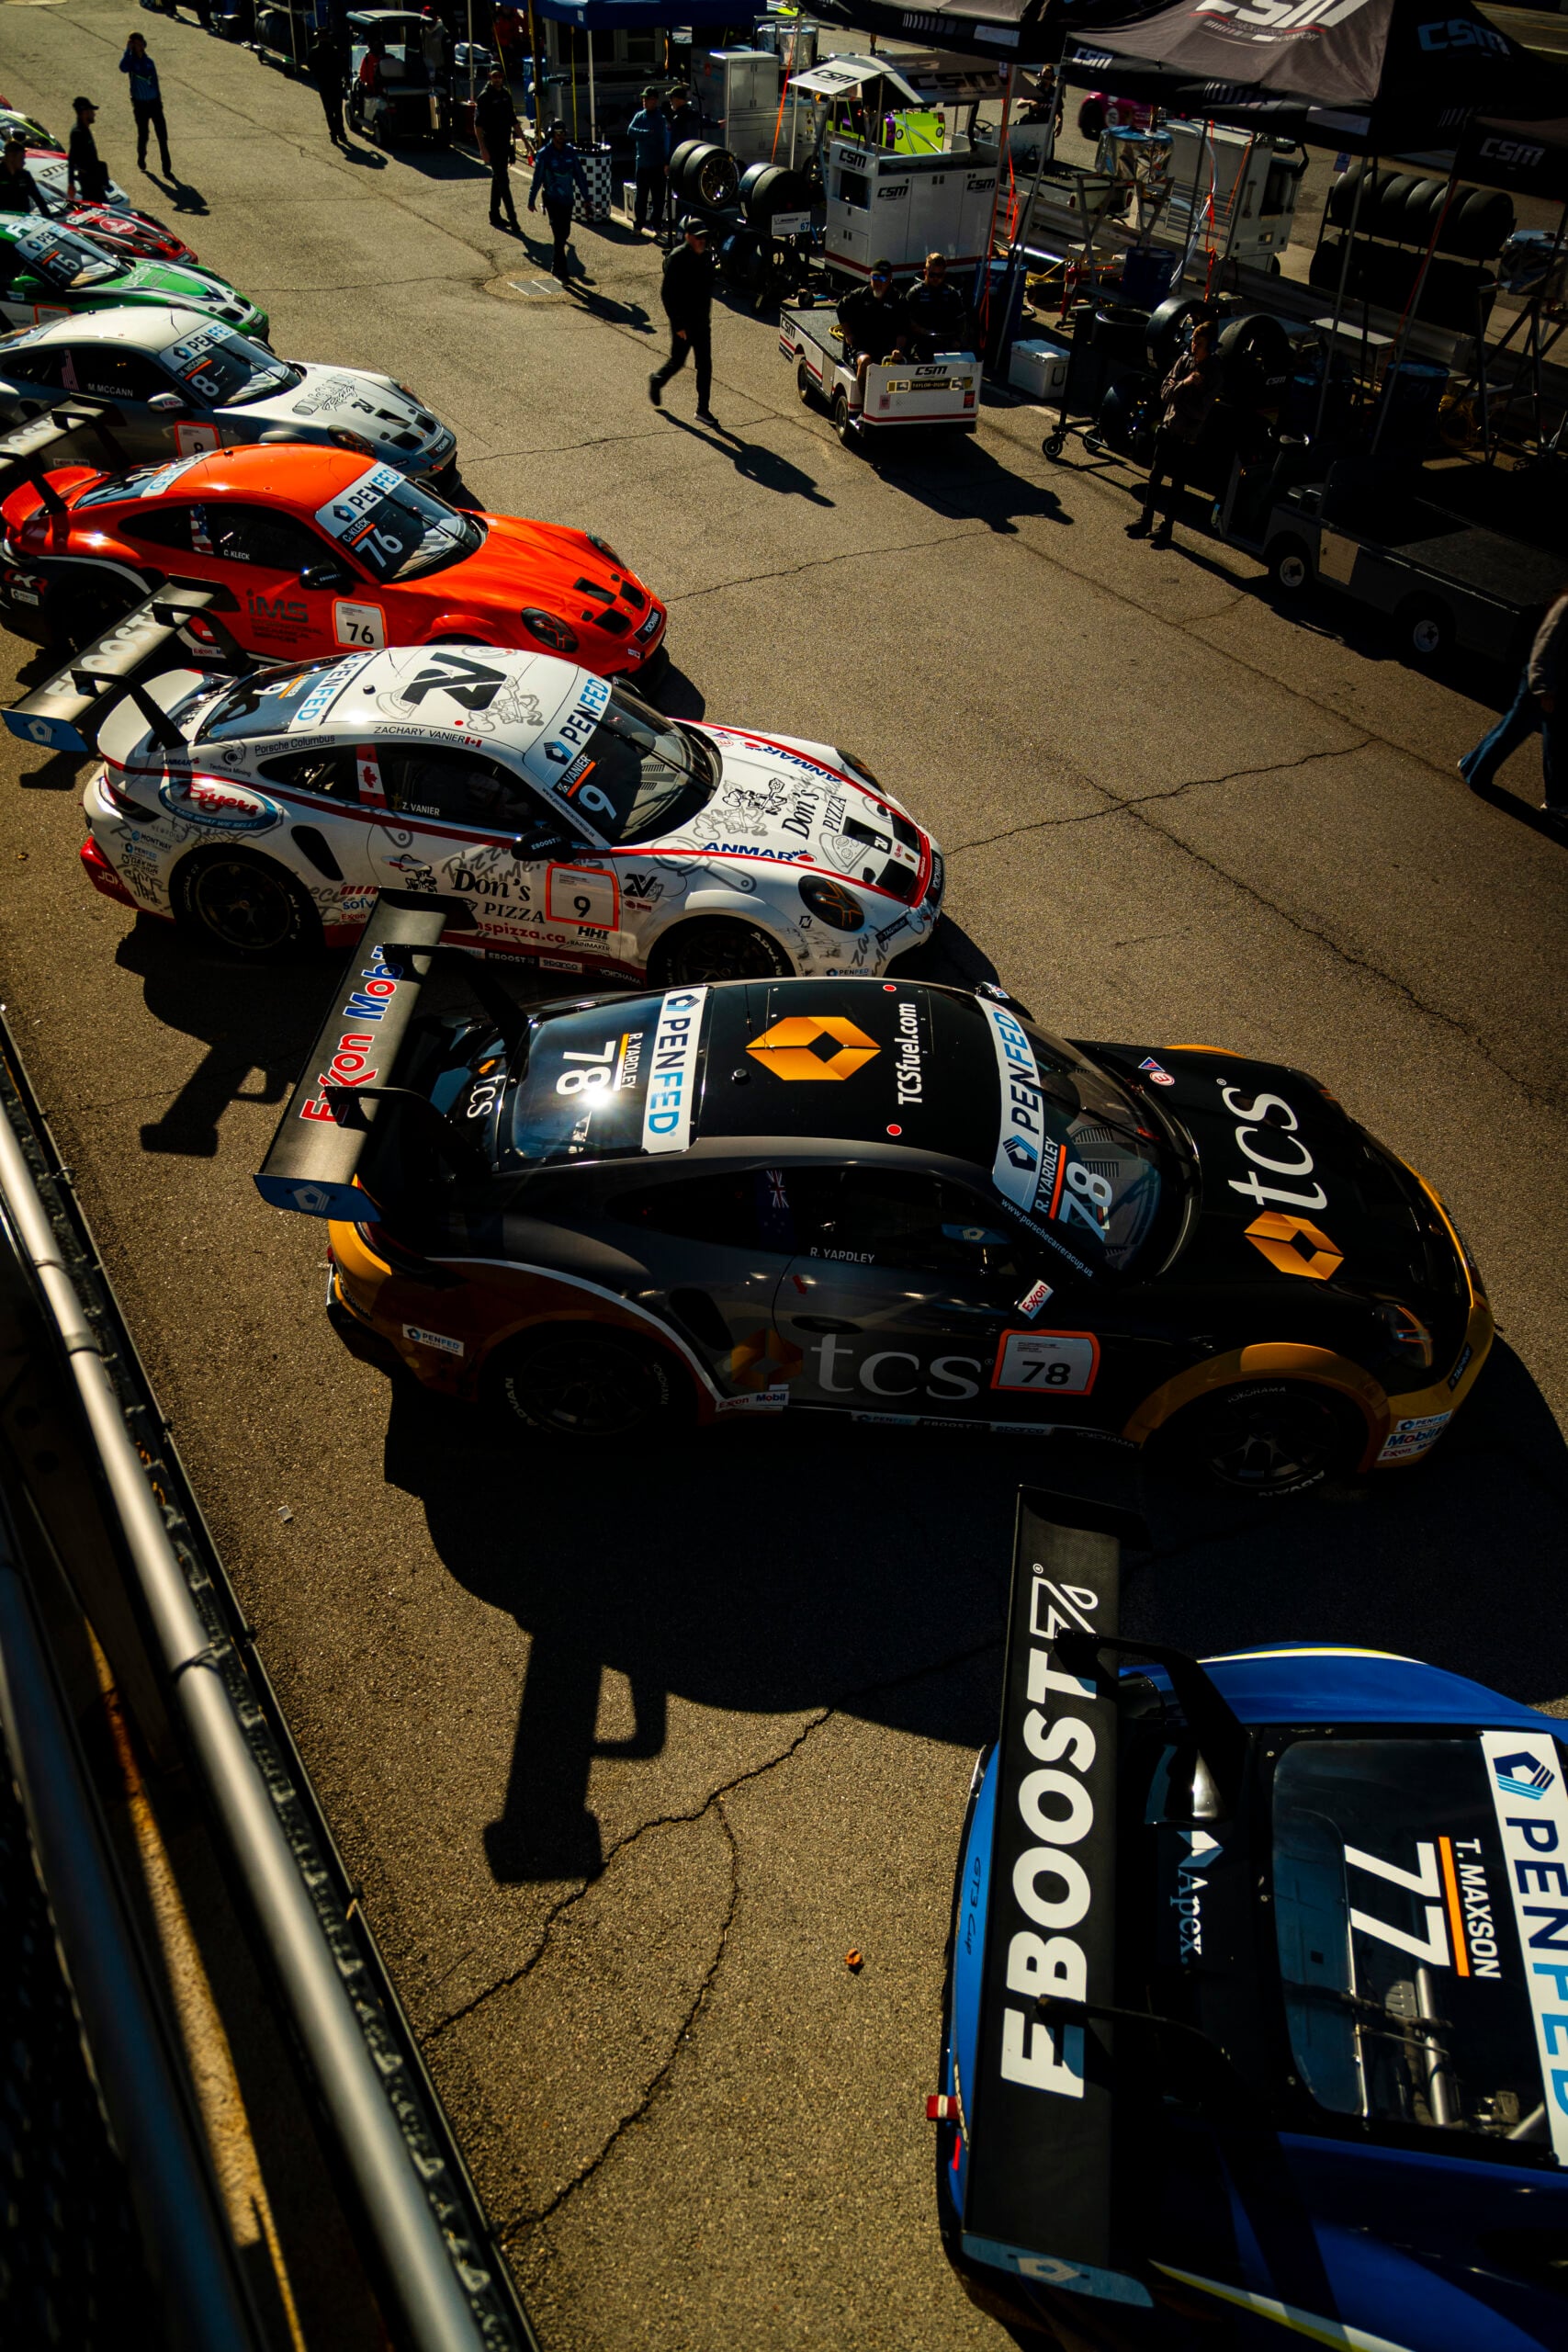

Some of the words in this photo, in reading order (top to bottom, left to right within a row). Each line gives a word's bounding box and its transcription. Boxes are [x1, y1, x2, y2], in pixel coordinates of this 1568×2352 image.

[1417, 18, 1512, 56] CSM
[1073, 47, 1113, 69] CSM
[811, 69, 860, 85] CSM
[839, 149, 867, 169] CSM
[1480, 137, 1546, 168] CSM
[877, 186, 908, 198] CSM
[967, 178, 996, 191] CSM
[49, 254, 81, 277] 15
[186, 323, 233, 352] PENFED
[781, 318, 795, 340] CSM
[191, 374, 220, 397] 8
[916, 366, 947, 376] CSM
[96, 384, 133, 398] MCCANN
[348, 469, 401, 511] PENFED
[350, 515, 371, 537] KLECK
[231, 550, 250, 560] KLECK
[355, 528, 403, 568] 76
[346, 622, 375, 645] 76
[298, 662, 356, 721] PENFED
[560, 678, 610, 746] PENFED
[254, 742, 289, 755] Porsche
[291, 734, 336, 751] Columbus
[374, 725, 425, 737] ZACHARY
[427, 729, 466, 744] VANIER
[570, 752, 593, 783] VANIER
[411, 803, 441, 816] VANIER
[579, 785, 617, 820] 9
[781, 789, 820, 841] Don's
[822, 794, 847, 833] PIZZA
[702, 842, 794, 863] ANMAR
[451, 868, 531, 902] Don's
[484, 902, 546, 923] PIZZA
[573, 896, 591, 918] 9
[343, 945, 405, 1021] Mob
[557, 1040, 617, 1096] 78
[620, 1045, 644, 1090] YARDLEY
[894, 1002, 923, 1105] TCSfuel.com
[298, 1031, 378, 1124] Exxon
[648, 1017, 693, 1136] PENFED
[993, 1012, 1041, 1136] PENFED
[466, 1073, 507, 1120] tcs
[1222, 1085, 1328, 1211] tcs
[1038, 1136, 1060, 1197] YARDLEY
[1058, 1161, 1114, 1243] 78
[999, 1197, 1095, 1279] www.porschecarreracup.us
[823, 1249, 875, 1266] YARDLEY
[1021, 1283, 1049, 1315] Exxon
[422, 1331, 460, 1350] PENFED
[810, 1332, 983, 1400] tcs
[1021, 1361, 1071, 1385] 78
[719, 1396, 750, 1408] Exxon
[756, 1393, 786, 1402] Mobil
[1387, 1428, 1437, 1446] Mobil
[969, 1855, 982, 1909] GT3
[1000, 1647, 1098, 2099] EBOOST
[1344, 1842, 1451, 1967] 77
[965, 1912, 976, 1957] Cup
[1457, 1864, 1502, 1979] MAXSON
